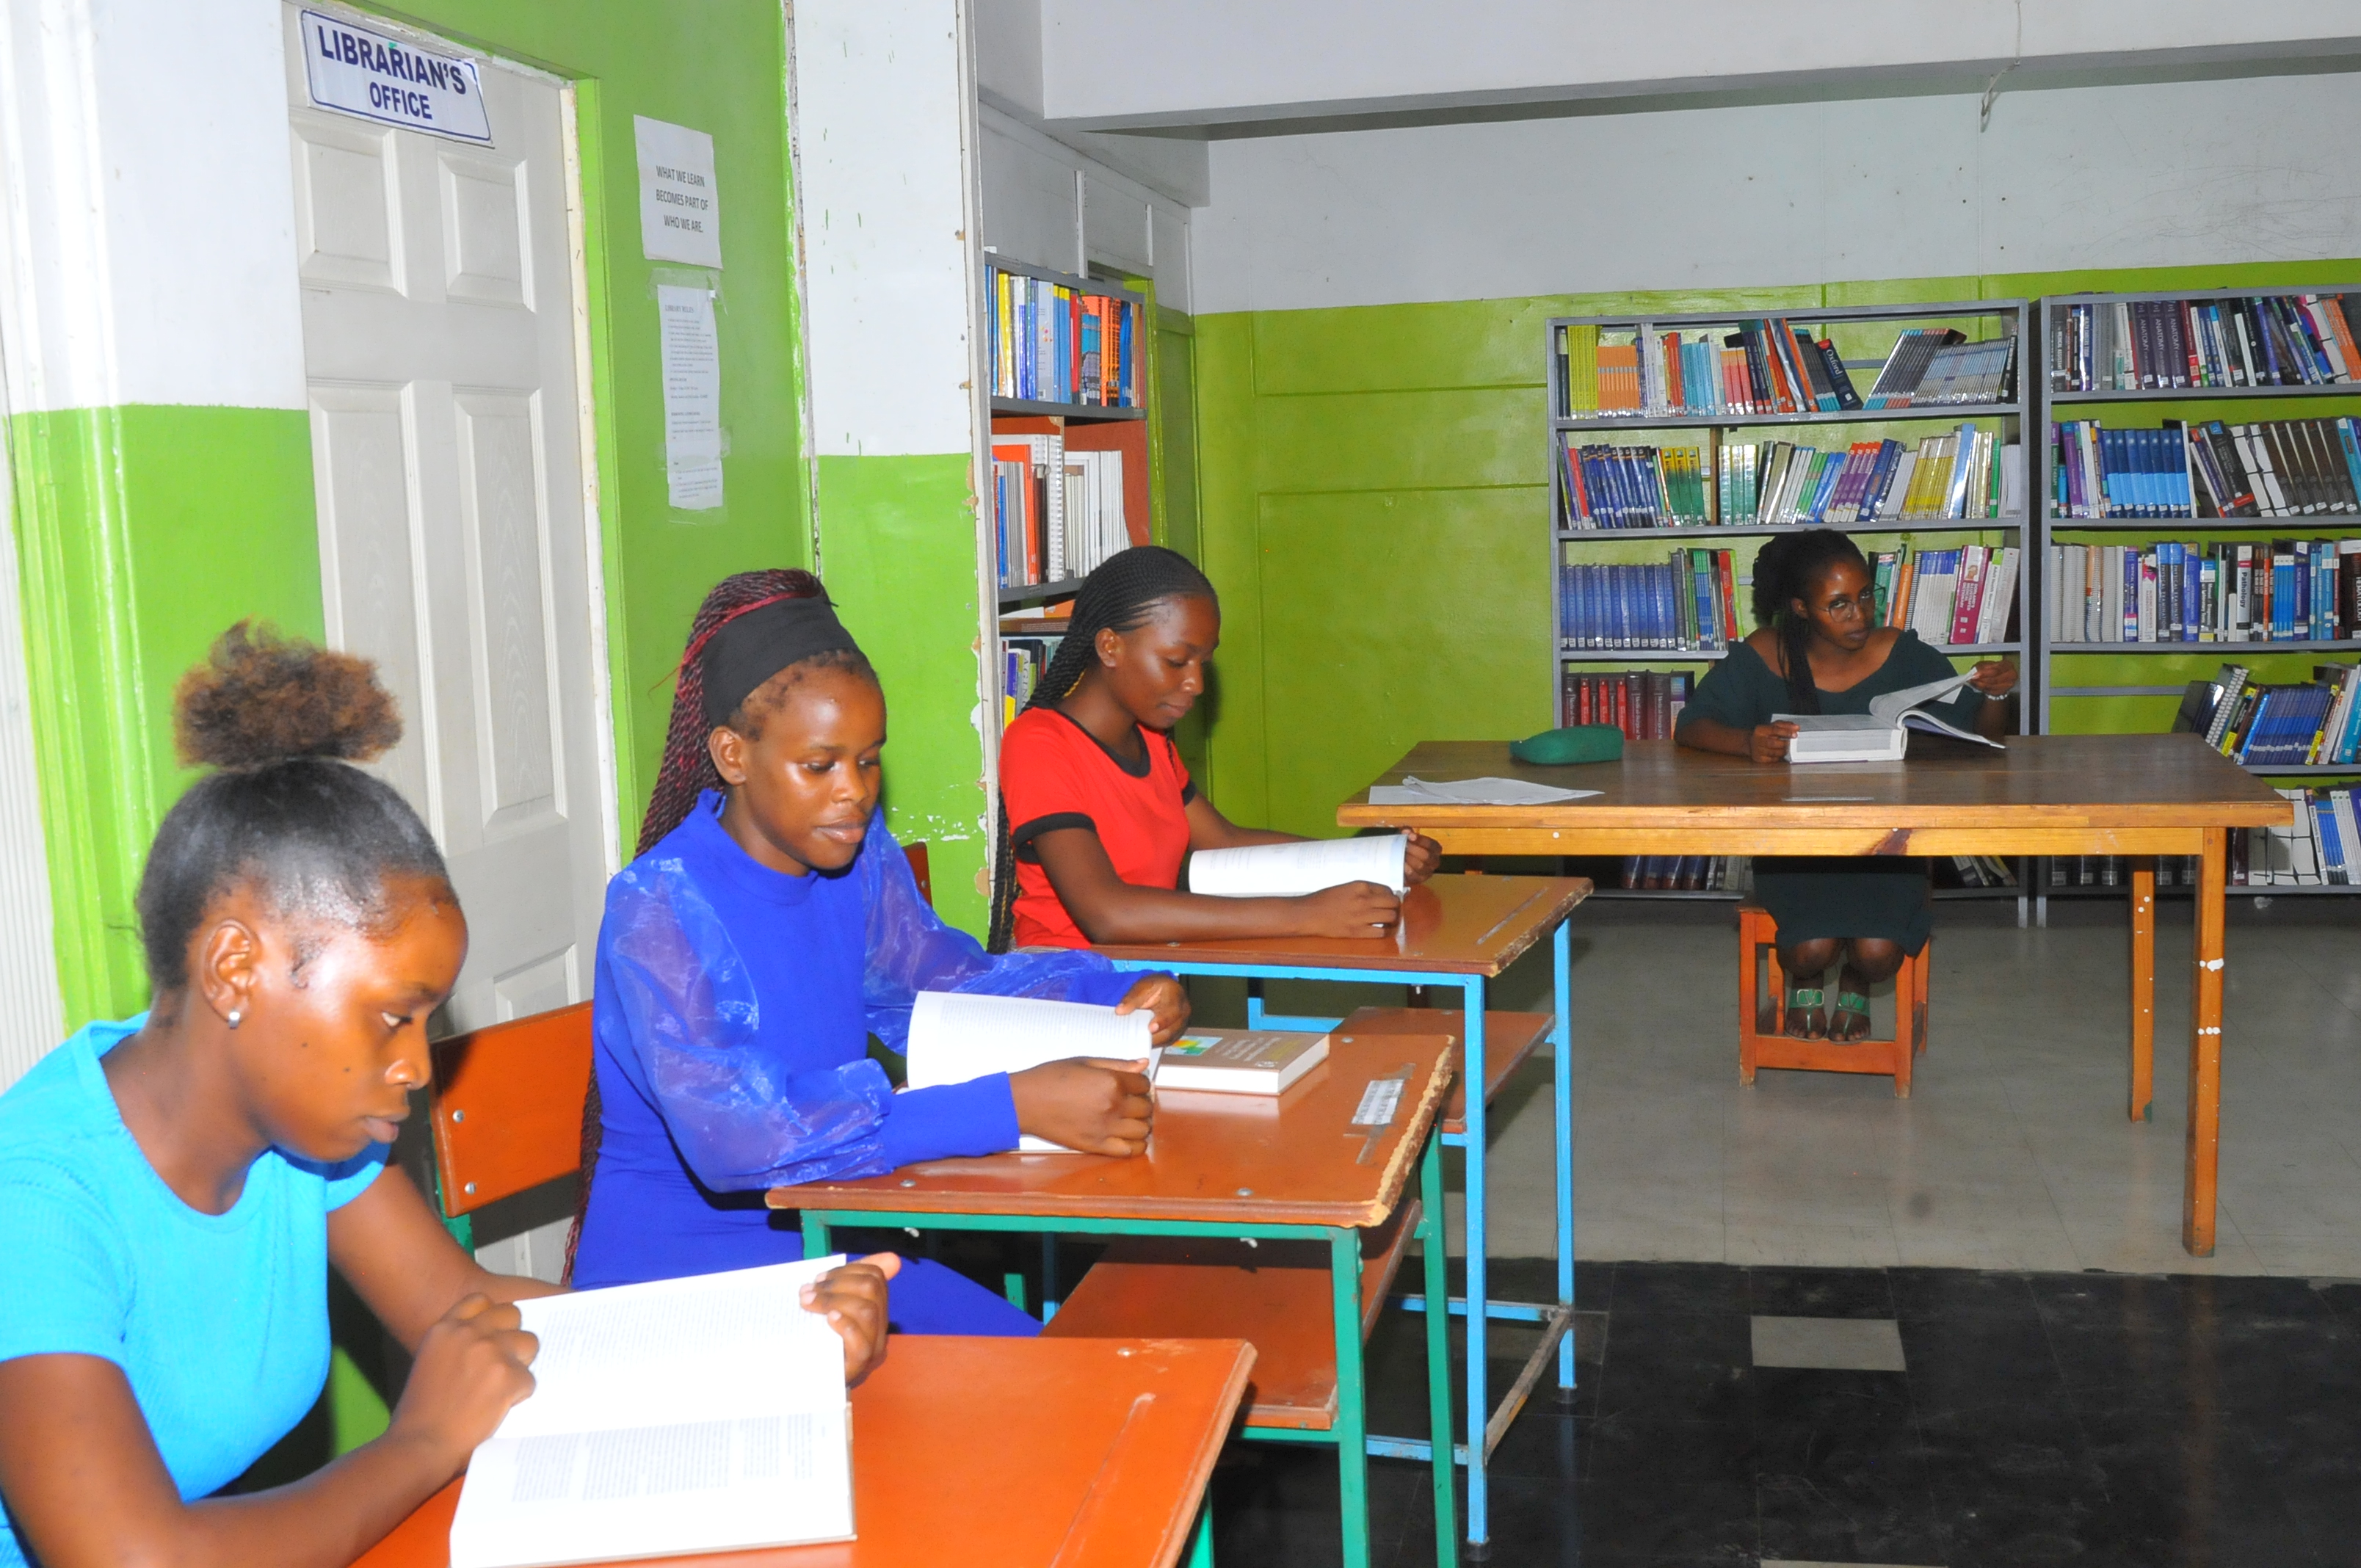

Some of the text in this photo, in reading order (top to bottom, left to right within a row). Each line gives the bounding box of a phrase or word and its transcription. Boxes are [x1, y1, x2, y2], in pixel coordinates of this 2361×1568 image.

[317, 24, 466, 95] LIBRARIAN'S
[369, 81, 433, 120] OFFICE
[656, 165, 705, 187] WHAT WE LEARN
[656, 189, 708, 211] BECOMES PART OF
[664, 214, 680, 229] WHO
[681, 217, 690, 231] WE
[2140, 319, 2149, 351] ANATOMY
[2155, 319, 2164, 351] ANATOMY
[2170, 318, 2180, 350] ANATOMY
[1827, 349, 1843, 374] Oxford
